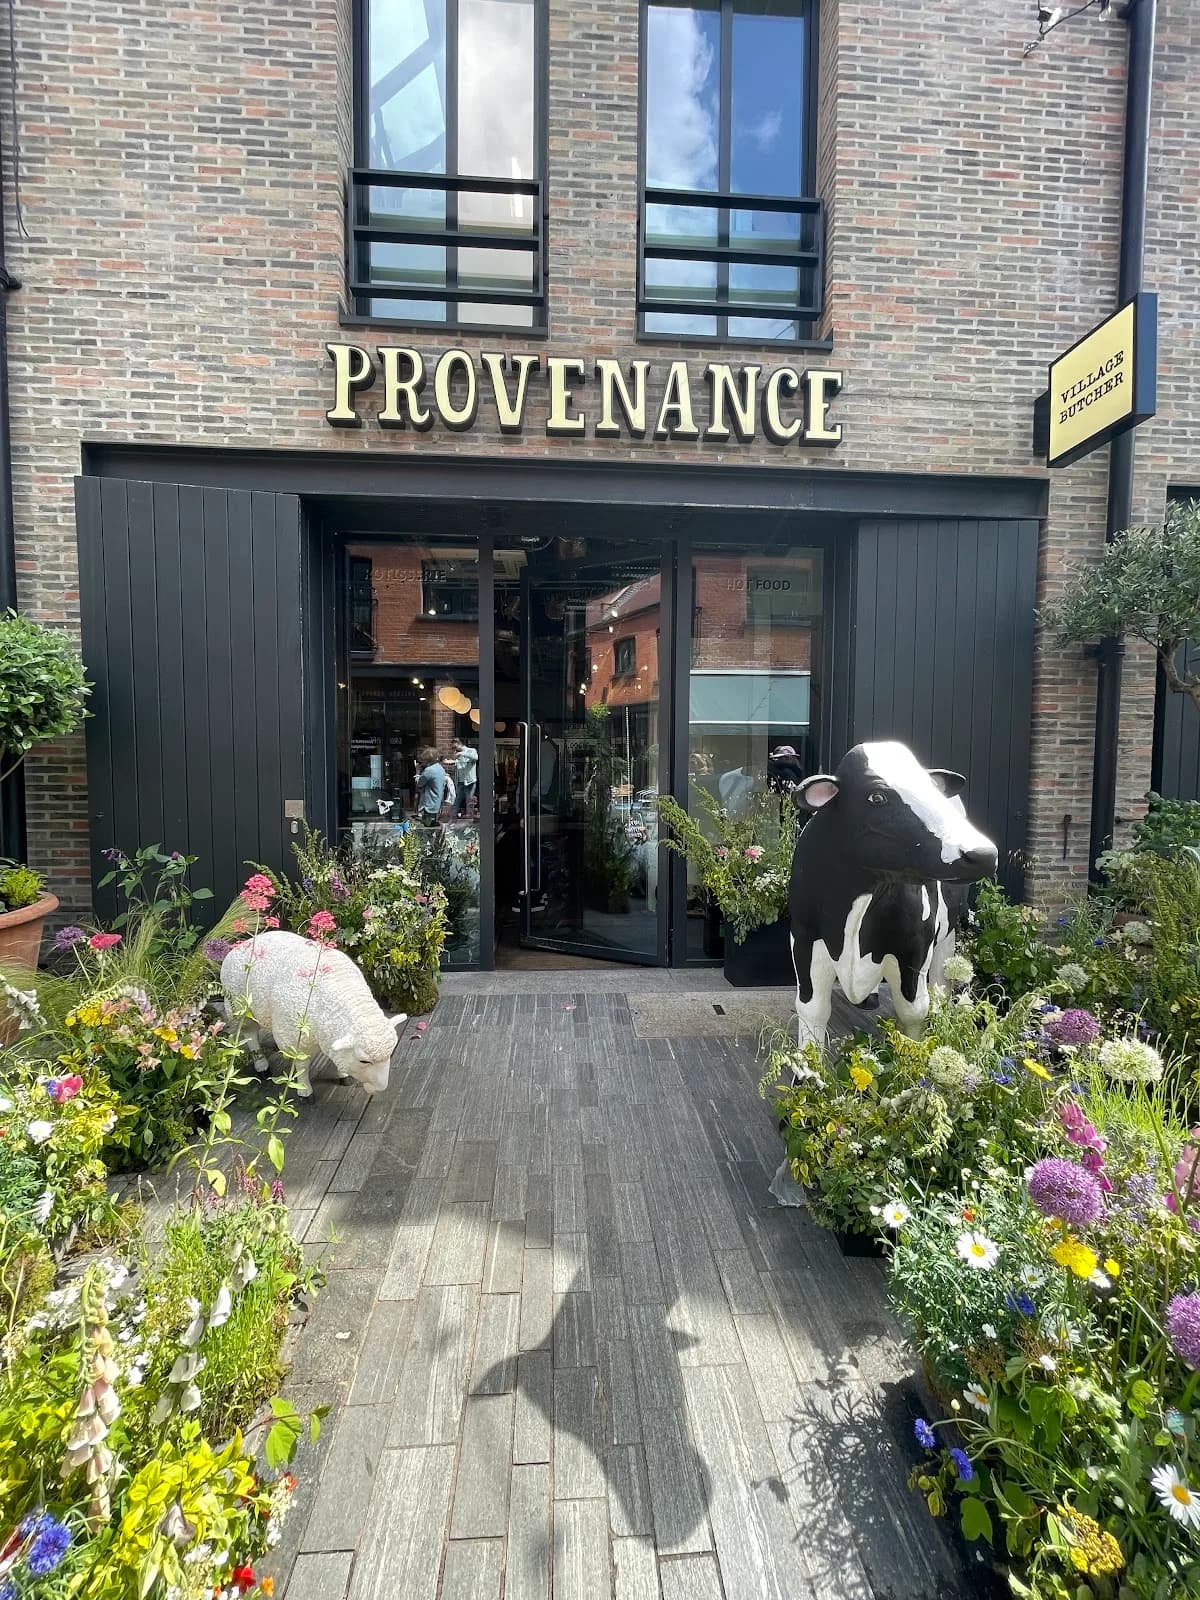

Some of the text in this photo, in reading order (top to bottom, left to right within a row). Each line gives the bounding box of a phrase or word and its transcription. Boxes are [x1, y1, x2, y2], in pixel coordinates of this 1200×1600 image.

[325, 343, 843, 447] PROVENANCE
[1059, 371, 1124, 424] BUTCHER
[1060, 350, 1124, 404] VILLAGE
[726, 577, 791, 592] HOT FOOD
